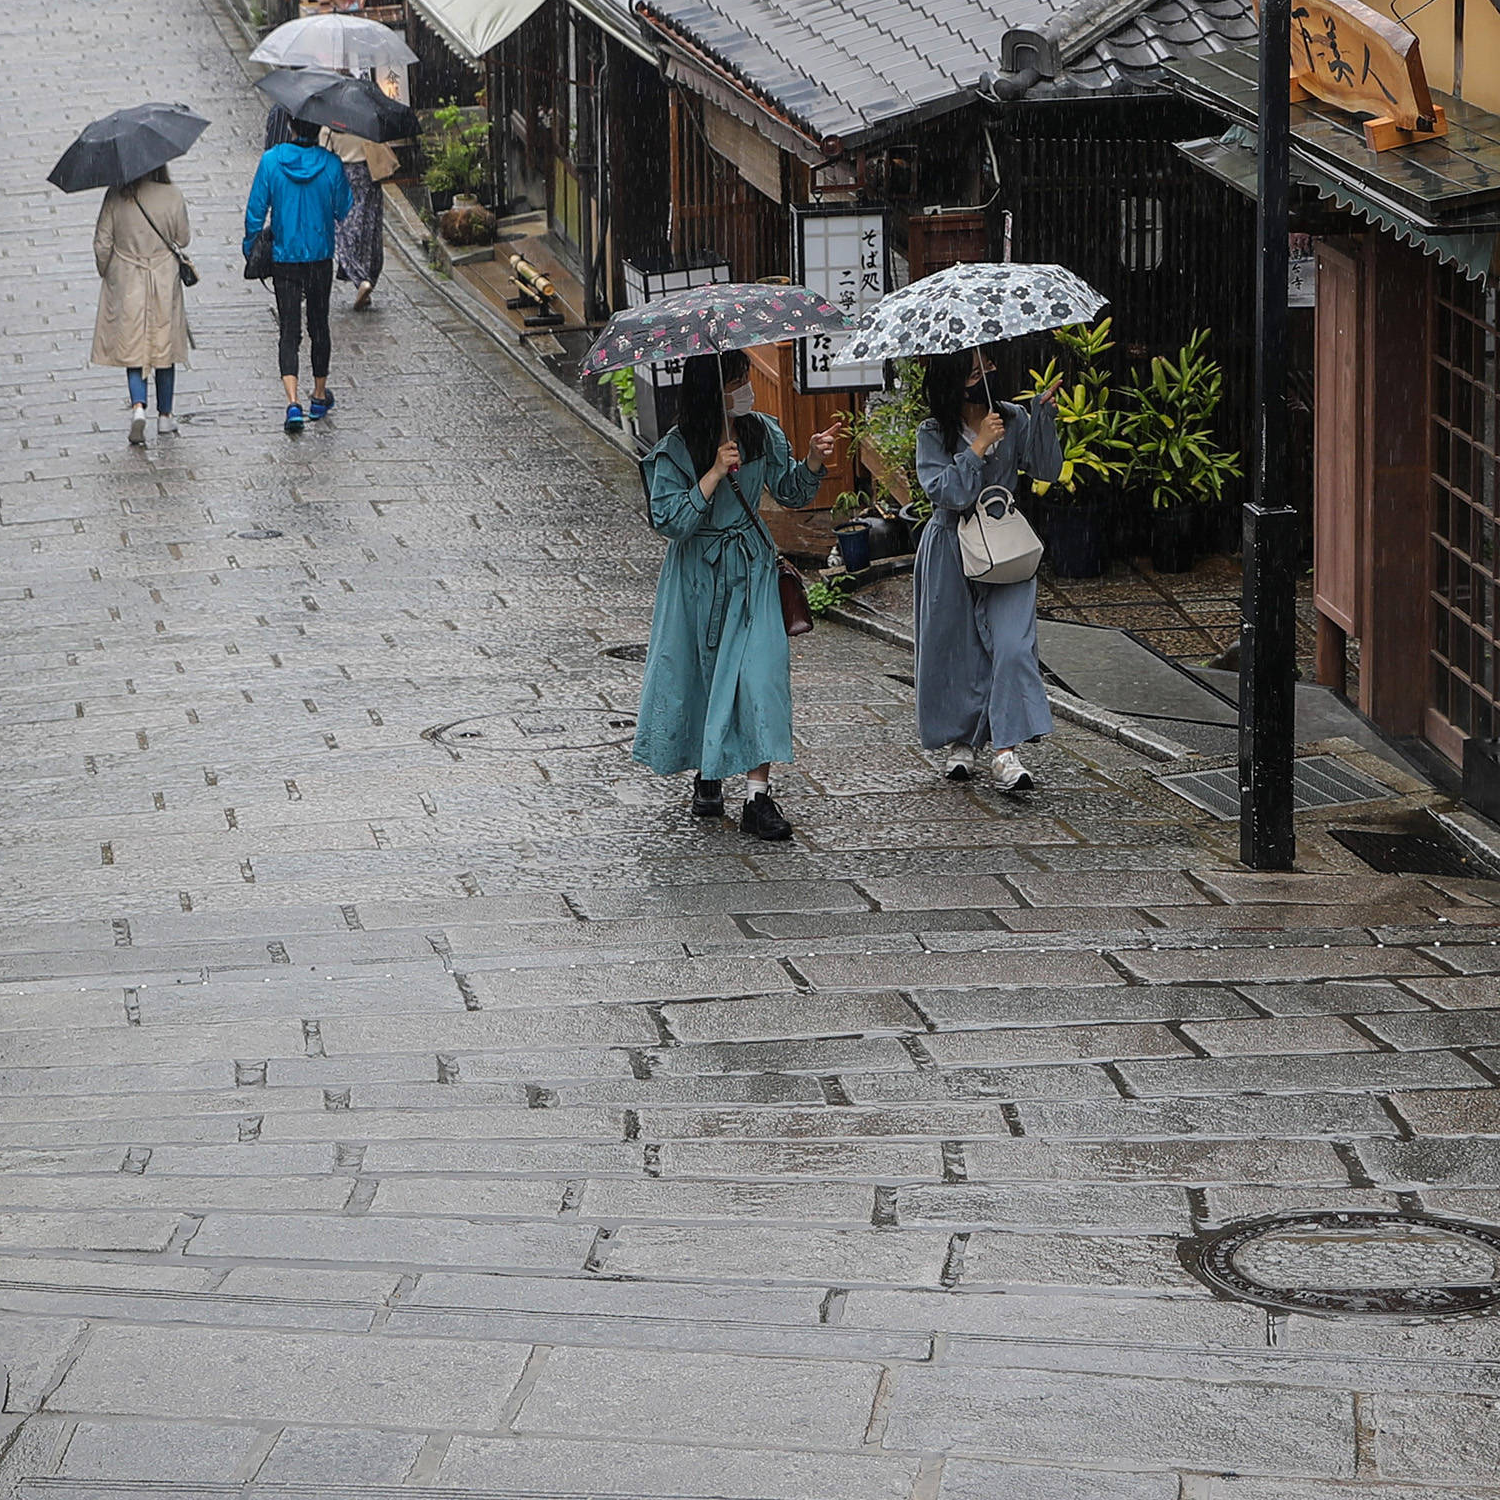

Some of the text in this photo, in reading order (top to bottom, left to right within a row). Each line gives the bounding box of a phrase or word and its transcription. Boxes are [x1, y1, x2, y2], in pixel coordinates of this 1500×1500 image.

[860, 229, 881, 293] そば処
[839, 270, 857, 318] 二寧
